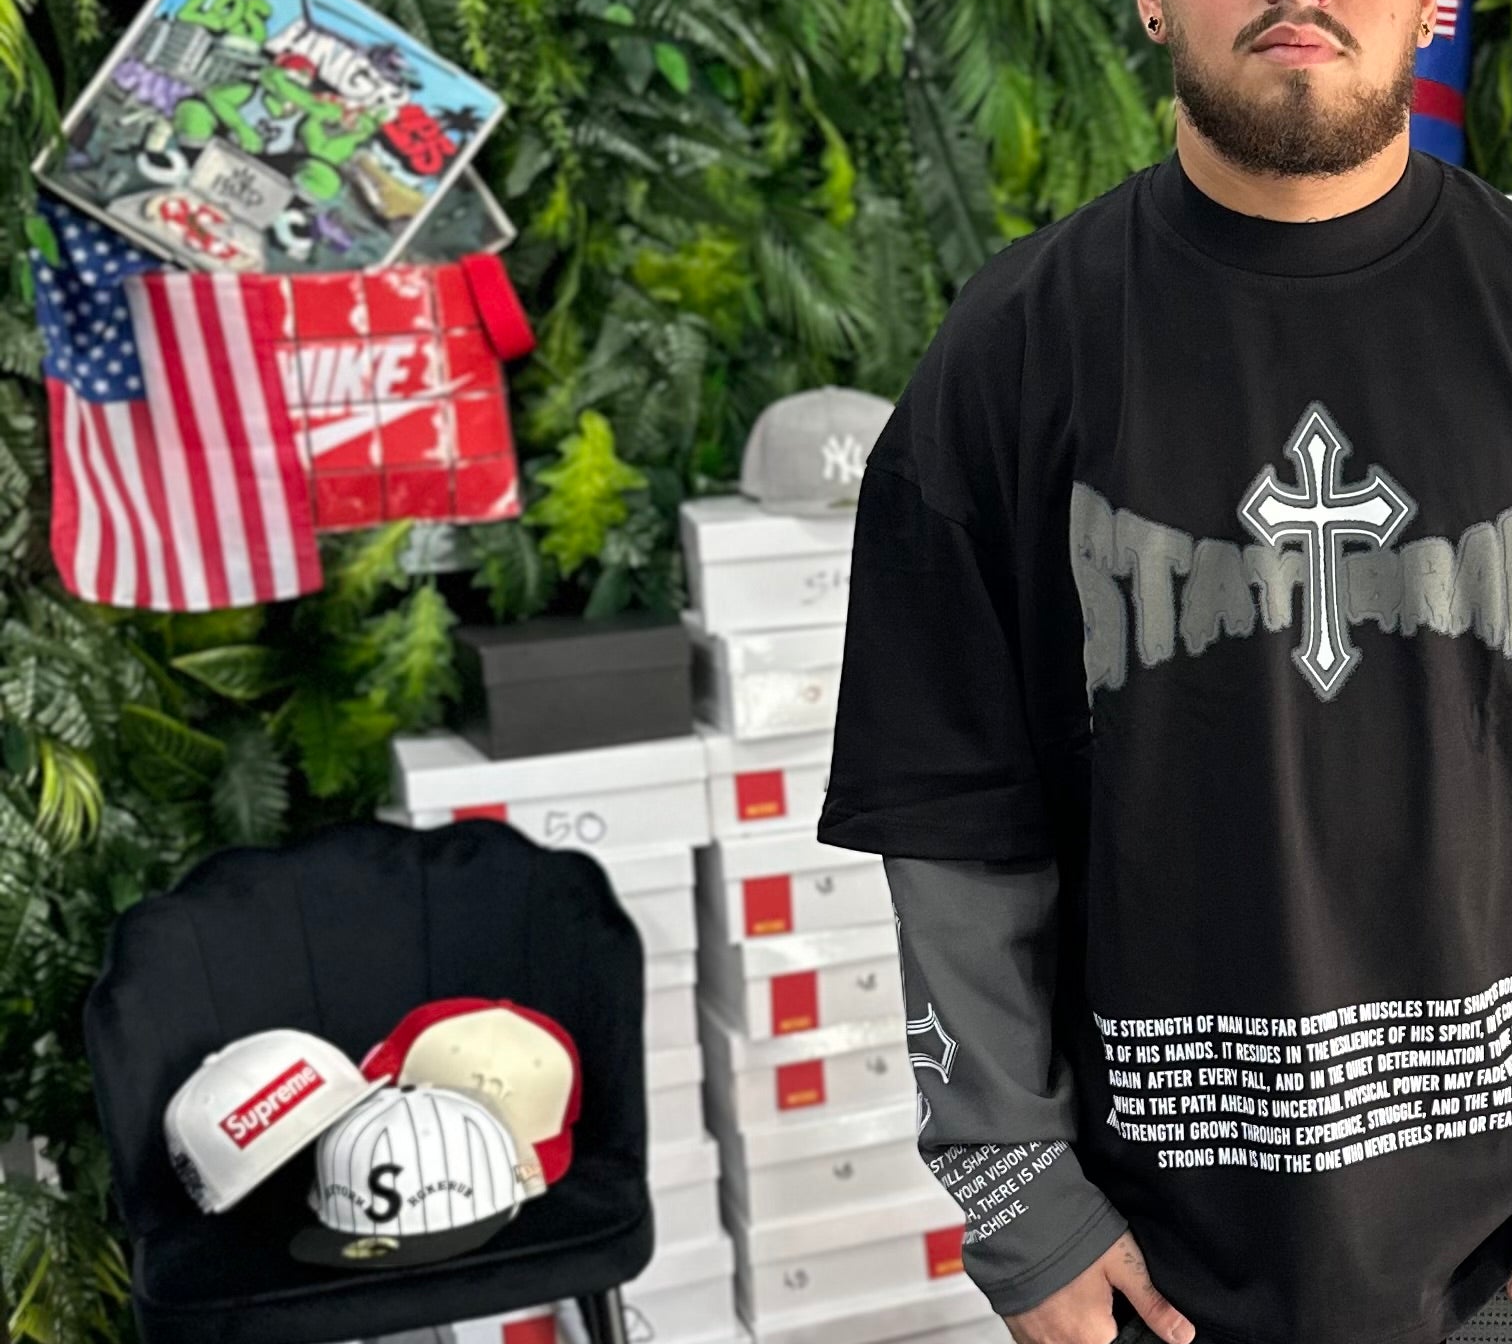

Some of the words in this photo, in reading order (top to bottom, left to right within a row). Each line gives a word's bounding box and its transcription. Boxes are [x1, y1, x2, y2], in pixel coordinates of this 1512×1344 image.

[277, 338, 417, 419] NIKE
[1117, 1045, 1132, 1063] OF
[1136, 1045, 1160, 1063] HIS
[1165, 1041, 1218, 1062] HANDS.
[1222, 1042, 1232, 1059] IT
[1236, 1043, 1281, 1064] RESIDES
[1286, 1045, 1301, 1064] IN
[1306, 1040, 1329, 1062] THE
[1388, 1026, 1406, 1044] OF
[1411, 1026, 1434, 1042] HIS
[1439, 1019, 1484, 1043] SPIRIT,
[1120, 1016, 1192, 1037] STRENGTH
[1197, 1015, 1214, 1033] OF
[1218, 1015, 1243, 1034] MAN
[1245, 1017, 1268, 1036] LIES
[1271, 1018, 1297, 1037] FAR
[1338, 1005, 1358, 1027] THE
[1359, 1000, 1423, 1022] MUSCLES
[1427, 999, 1461, 1017] THAT
[1109, 1069, 1141, 1089] AGAIN
[1148, 1069, 1193, 1089] AFTER
[1199, 1067, 1238, 1086] EVERY
[1242, 1070, 1271, 1092] FALL,
[1275, 1072, 1304, 1091] AND
[1310, 1069, 1325, 1089] IN
[1345, 1056, 1373, 1080] QUIET
[1377, 1045, 1485, 1074] DETERMINATION
[1113, 1094, 1145, 1115] WHEN
[1149, 1097, 1177, 1115] THE
[1181, 1095, 1216, 1114] PATH
[1220, 1094, 1254, 1115] AHEAD
[1257, 1099, 1268, 1117] IS
[1393, 1075, 1440, 1096] POWER
[1444, 1070, 1474, 1091] MAY
[1477, 1063, 1507, 1086] FADE
[226, 1064, 318, 1140] Supreme
[1121, 1121, 1184, 1142] STRENGTH
[1190, 1121, 1238, 1140] GROWS
[1241, 1122, 1290, 1145] THROUGH
[1367, 1100, 1426, 1131] STRUGGLE,
[1431, 1098, 1461, 1117] AND
[1464, 1092, 1488, 1113] THE
[927, 1155, 944, 1174] ST
[962, 1143, 1000, 1174] SHAPE
[1158, 1148, 1214, 1169] STRONG
[1219, 1148, 1247, 1166] MAN
[1249, 1150, 1258, 1168] IS
[1260, 1154, 1281, 1172] NOT
[1284, 1154, 1312, 1173] THE
[1315, 1149, 1342, 1172] ONE
[1342, 1142, 1364, 1165] WHO
[1364, 1133, 1398, 1158] NEVER
[1398, 1125, 1433, 1149] FEELS
[1436, 1121, 1466, 1141] PAIN
[1469, 1116, 1486, 1135] OR
[365, 1163, 402, 1223] S
[954, 1175, 988, 1203] YOUR
[985, 1145, 1028, 1181] VISION
[976, 1178, 1020, 1213] THERE
[1017, 1167, 1034, 1185] IS
